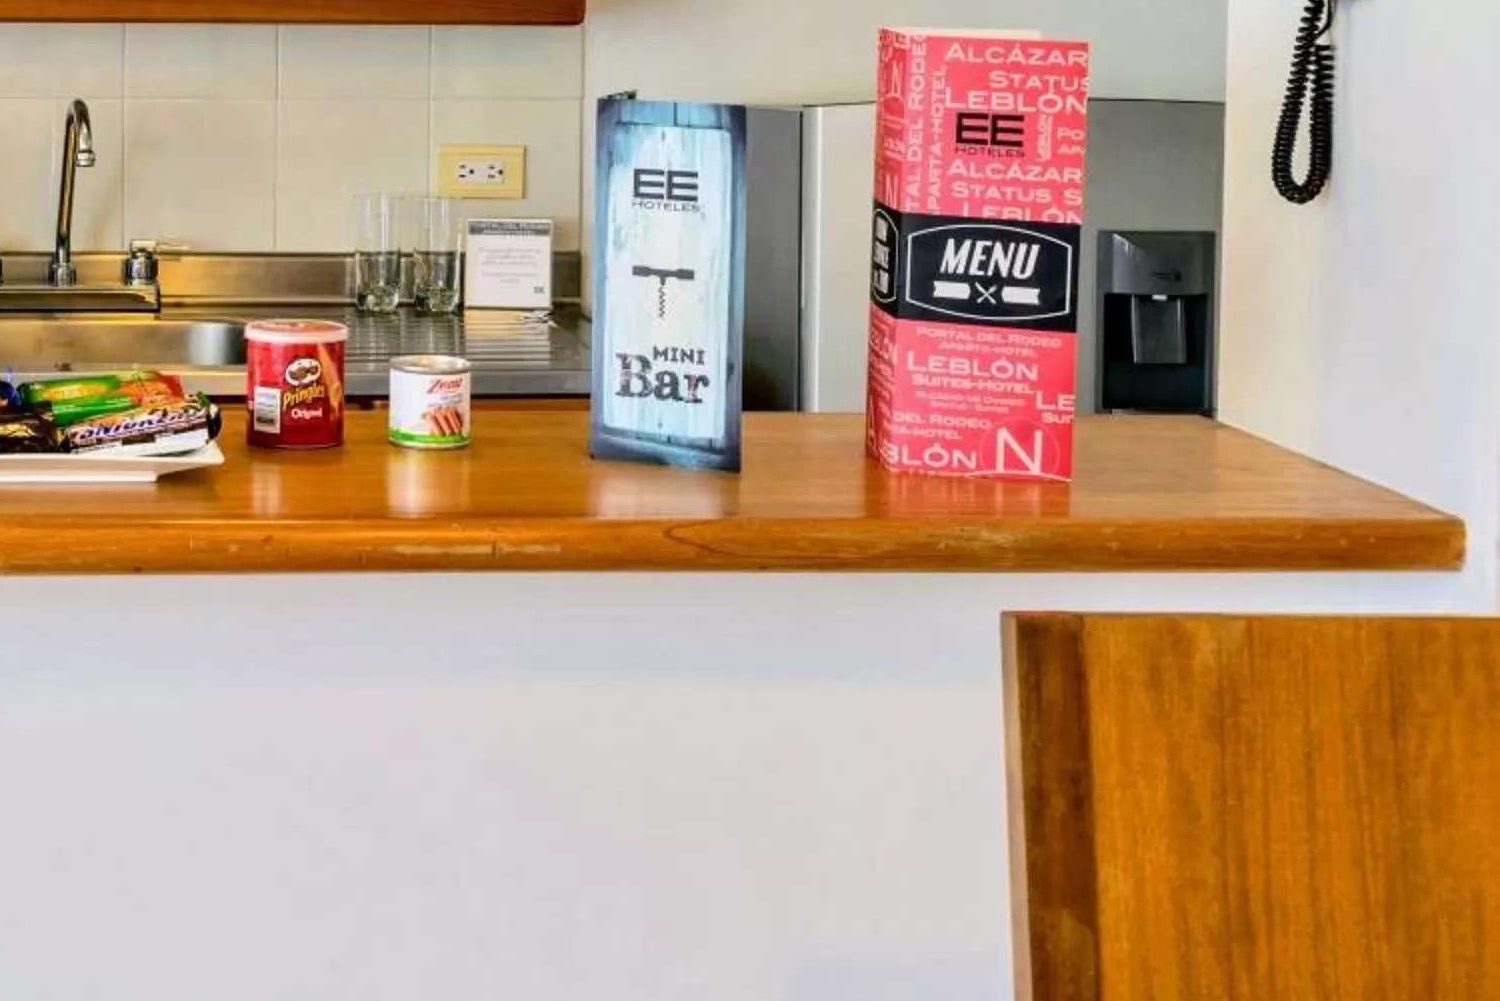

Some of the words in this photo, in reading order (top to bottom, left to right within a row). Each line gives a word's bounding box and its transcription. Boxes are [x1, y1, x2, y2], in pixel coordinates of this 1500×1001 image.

[944, 43, 1088, 67] ALCÁZAR
[955, 112, 1024, 148] EE
[955, 146, 1025, 158] HOTELES
[947, 159, 1082, 184] ALCÁZAR
[633, 168, 699, 201] EE
[950, 182, 1051, 203] STATUS
[631, 200, 701, 213] HOTELES
[939, 238, 1041, 280] MENU
[916, 326, 973, 341] PORTAL
[976, 331, 1005, 344] DEL
[1008, 334, 1062, 348] RODEO
[652, 346, 706, 366] MINI
[907, 350, 1039, 381] LEBLÓN
[615, 352, 710, 404] Bar
[283, 383, 325, 411] Pringles
[930, 414, 992, 430] RODEO
[996, 426, 1043, 473] N
